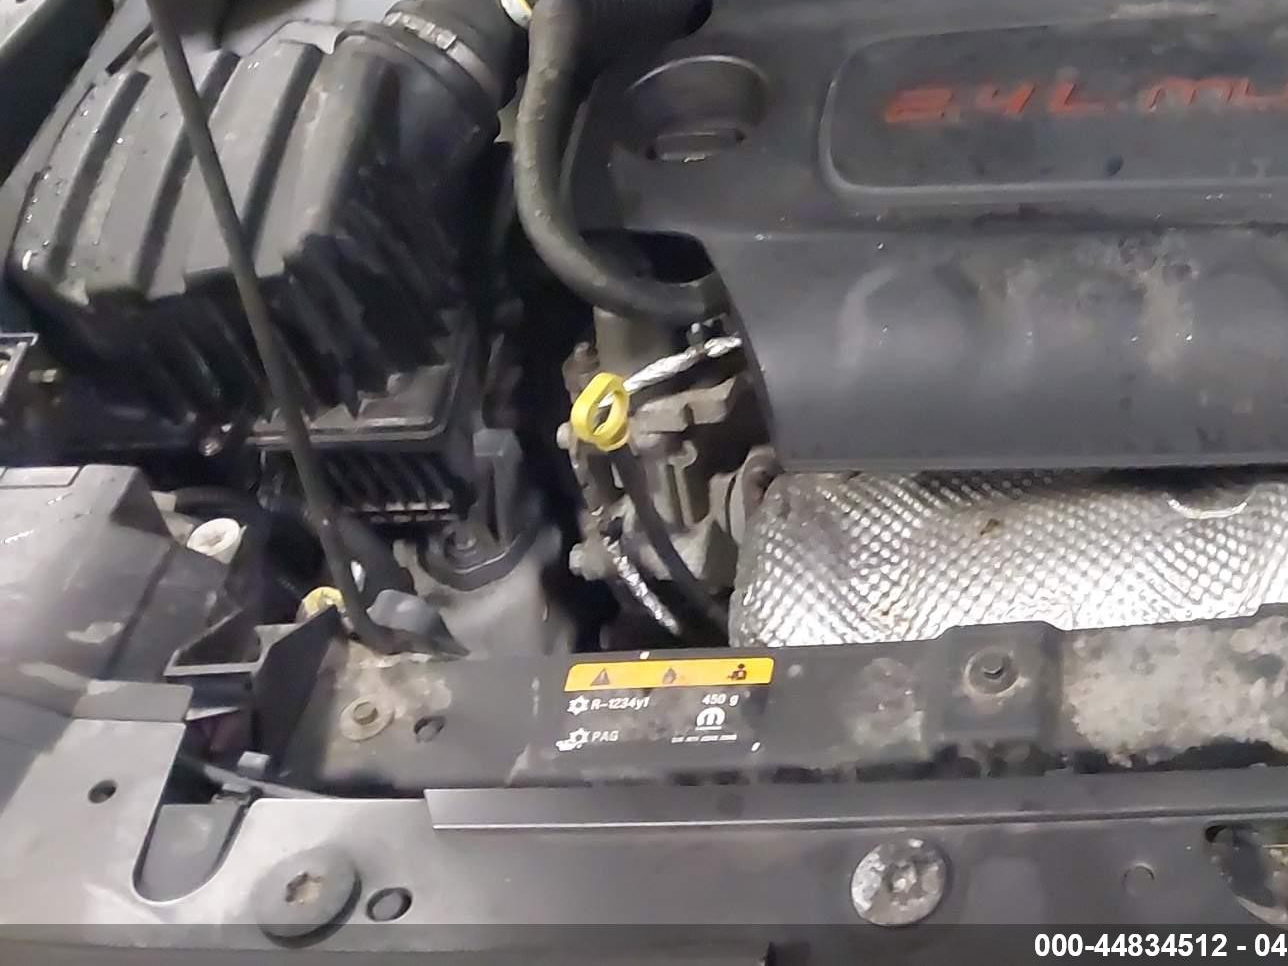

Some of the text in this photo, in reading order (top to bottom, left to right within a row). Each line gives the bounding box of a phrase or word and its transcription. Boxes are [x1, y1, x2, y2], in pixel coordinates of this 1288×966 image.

[701, 693, 726, 706] 450
[729, 693, 740, 707] g
[590, 730, 619, 743] PAG
